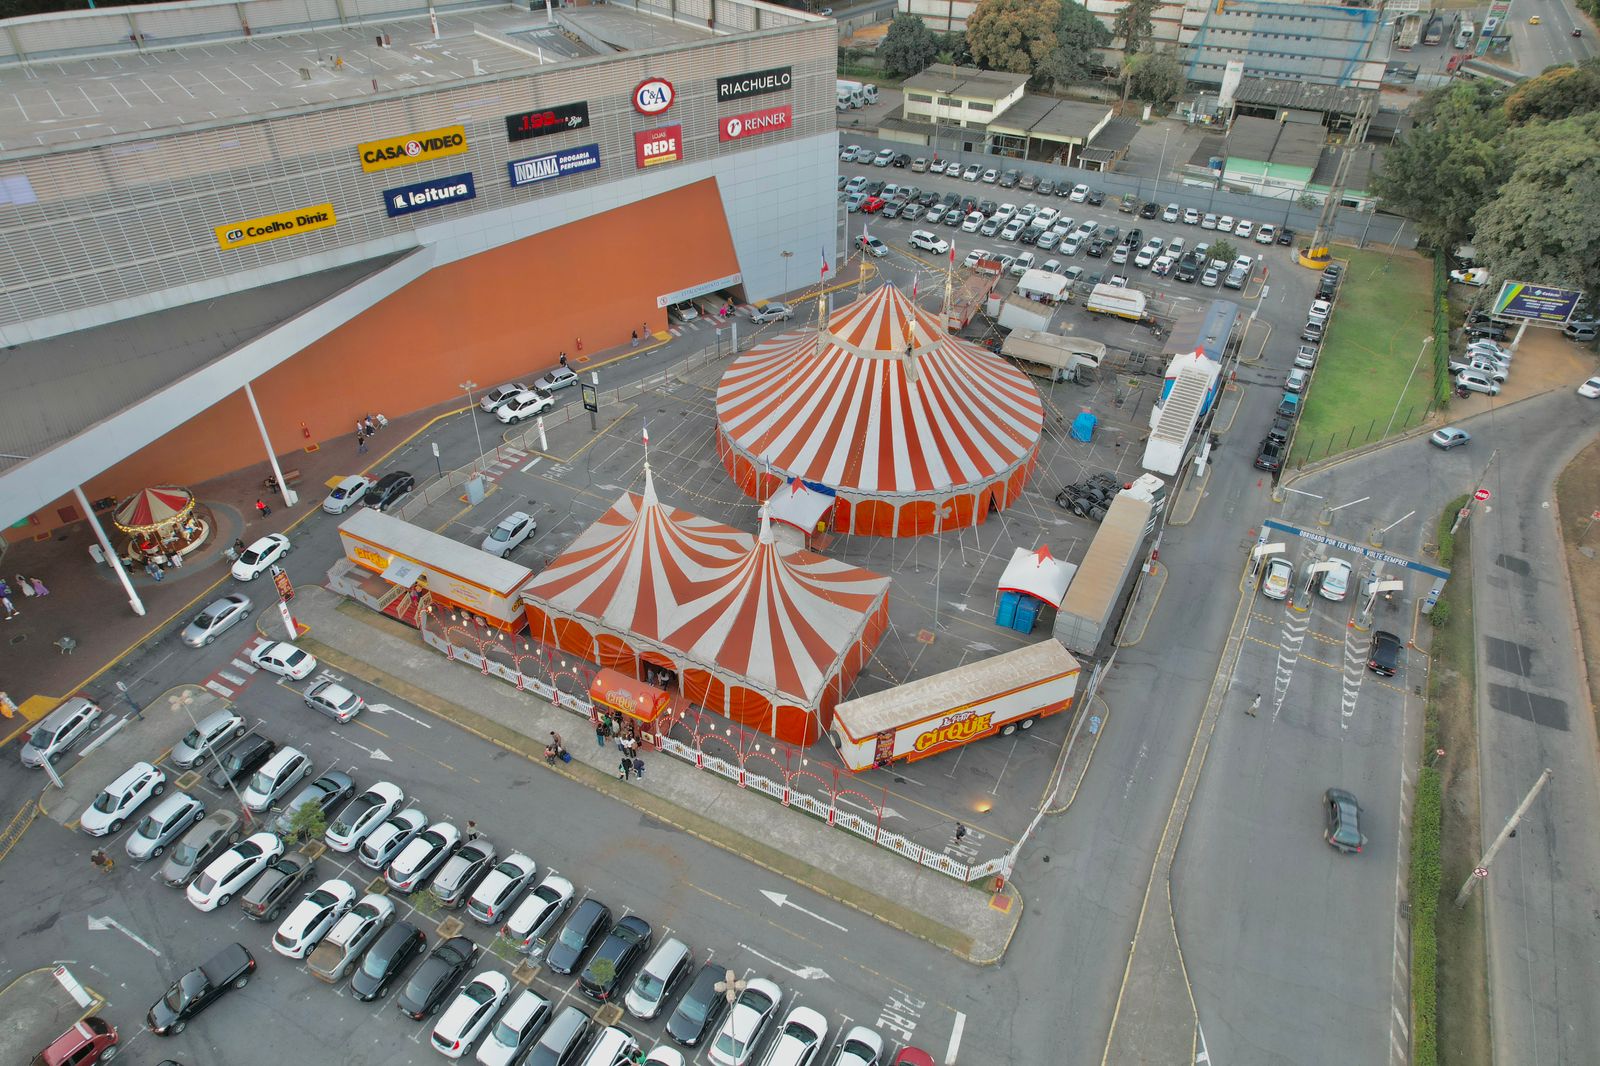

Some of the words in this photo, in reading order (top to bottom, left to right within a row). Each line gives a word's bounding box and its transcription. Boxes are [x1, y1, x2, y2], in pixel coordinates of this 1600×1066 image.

[721, 73, 790, 96] RIACHUELO
[640, 87, 667, 106] C&A
[744, 112, 786, 131] RENNER
[643, 138, 676, 156] REDE
[651, 132, 666, 140] LOJAS
[363, 133, 463, 164] CASA&VIDEO
[559, 151, 590, 164] DROGARIA
[513, 158, 559, 182] INDIANA
[560, 157, 597, 171] PERFUMARIA
[408, 183, 468, 206] leitura
[227, 229, 244, 240] CD
[246, 221, 294, 238] Coelho
[296, 211, 329, 227] Diniz
[1299, 530, 1325, 543] OBRIGADO
[1324, 538, 1336, 547] POR
[1336, 541, 1348, 550] TER
[1366, 548, 1383, 560] VOLTE
[1383, 553, 1408, 567] SEMPRE!
[875, 988, 926, 1042] PARE
